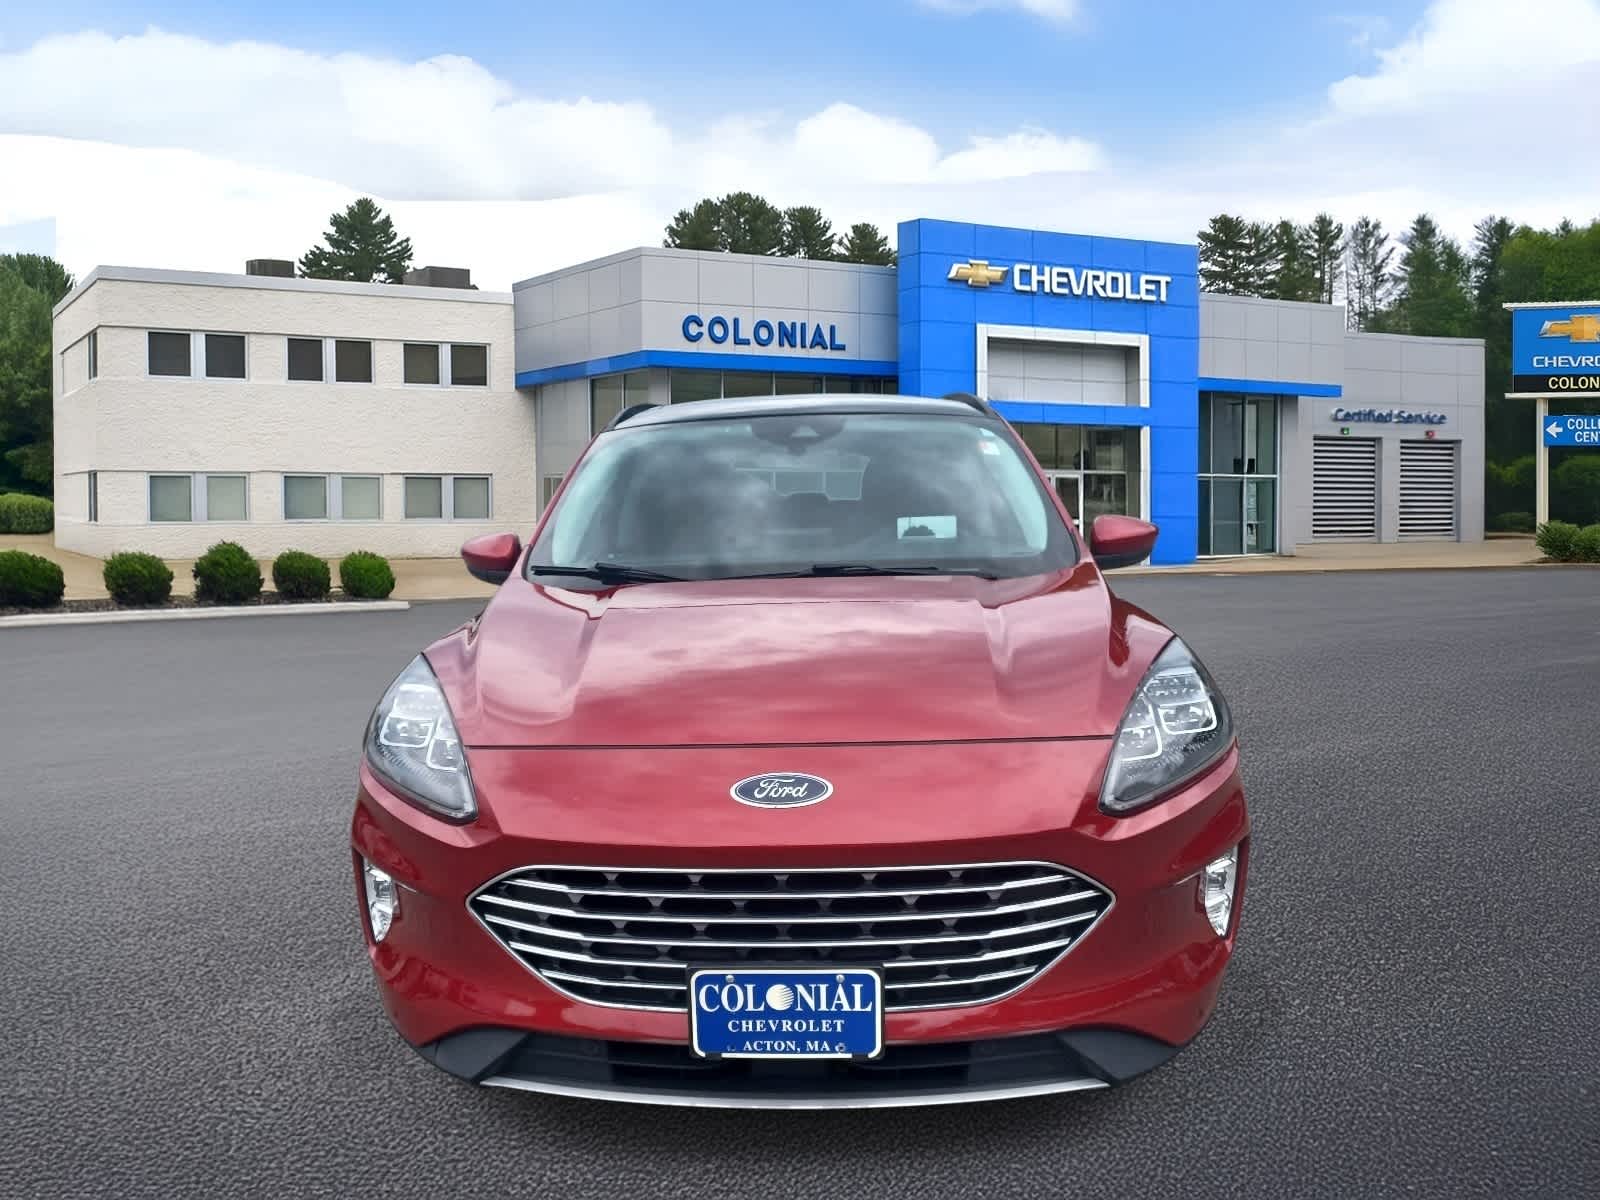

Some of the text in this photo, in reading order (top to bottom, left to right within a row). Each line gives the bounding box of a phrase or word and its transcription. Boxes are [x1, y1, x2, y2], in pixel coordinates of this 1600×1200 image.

[1013, 263, 1171, 302] CHEVROLET
[682, 314, 846, 351] COLONIAL
[1334, 408, 1447, 425] Certified Service
[754, 778, 808, 799] Ford
[699, 983, 872, 1012] COLONIAL
[727, 1019, 846, 1033] CHEVROLET
[743, 1040, 831, 1053] ACTON, MA
